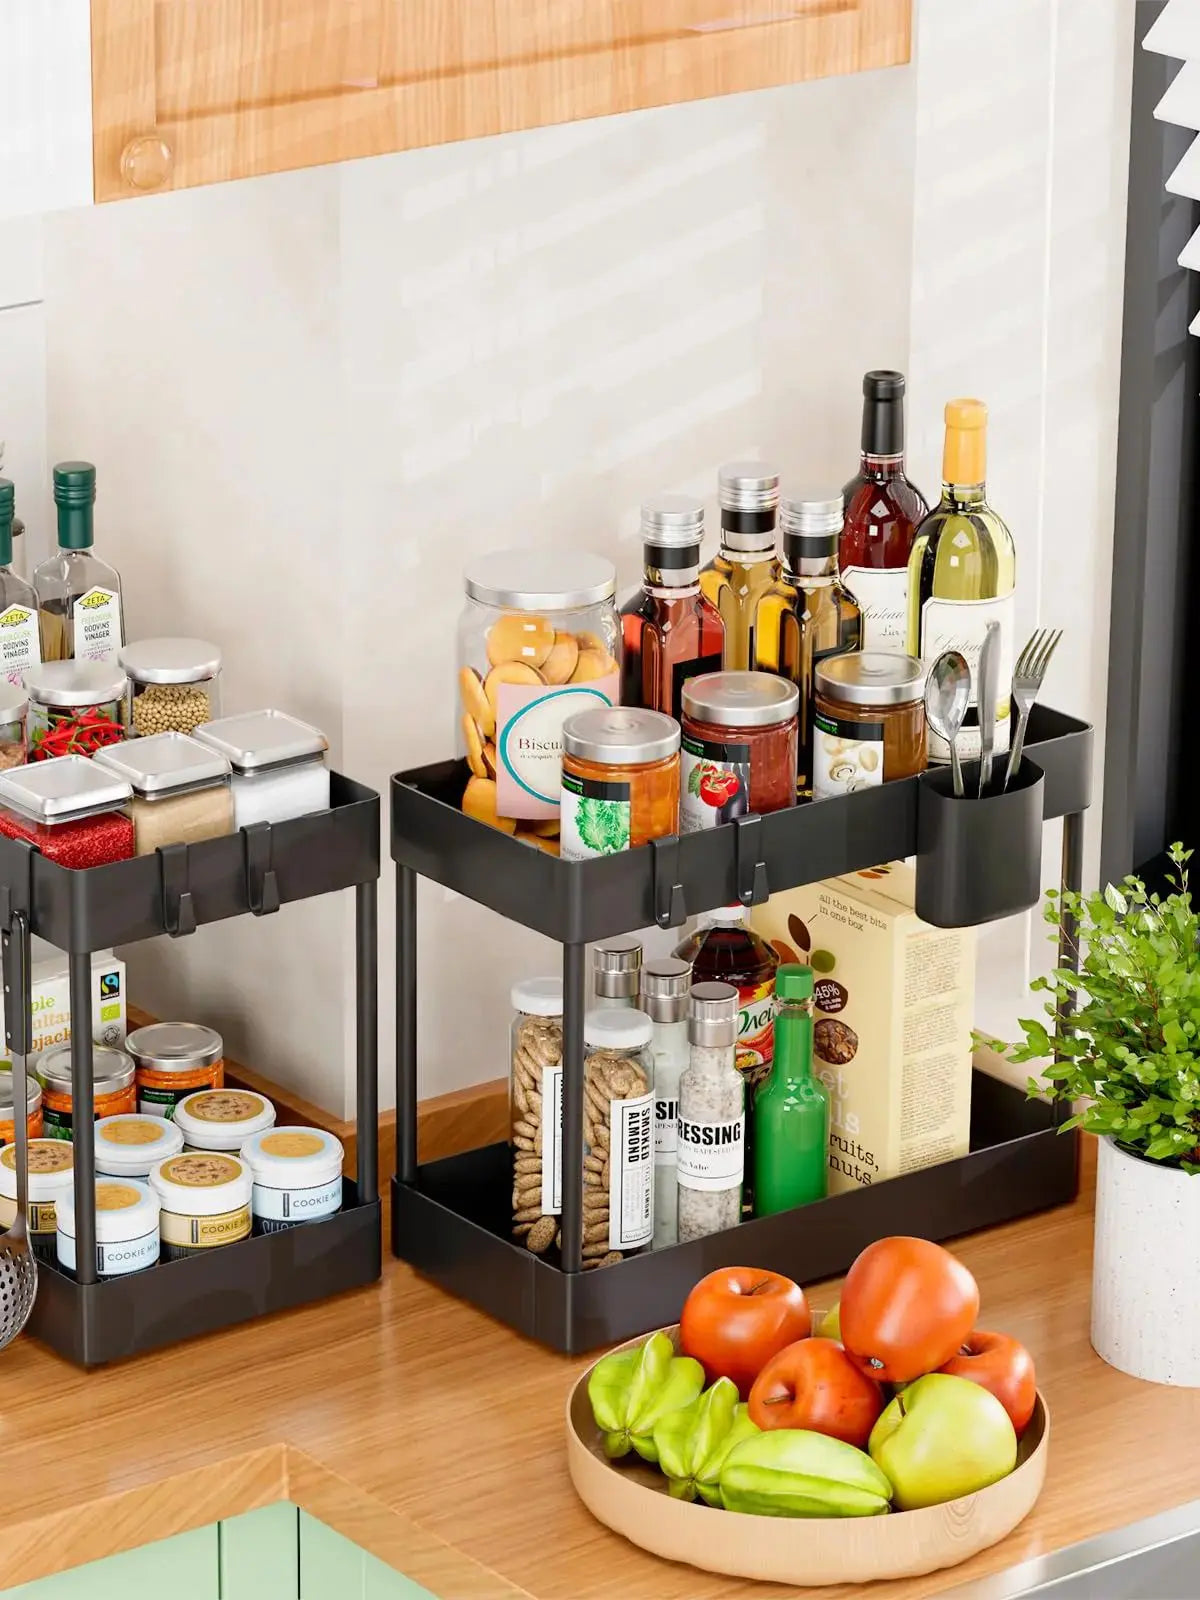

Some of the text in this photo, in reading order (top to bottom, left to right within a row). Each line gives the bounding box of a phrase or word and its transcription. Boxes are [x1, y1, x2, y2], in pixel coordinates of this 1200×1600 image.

[87, 595, 105, 605] ZETA
[5, 613, 24, 622] ZETA
[84, 630, 110, 641] VINAGER
[3, 648, 29, 659] VINAGER
[819, 894, 887, 930] all the best bits
[830, 911, 847, 924] one
[847, 917, 864, 932] box
[815, 983, 841, 999] 45%
[628, 1107, 651, 1163] SMOKED ALMOND
[678, 1118, 742, 1146] RESSING
[829, 1132, 879, 1173] ruits,
[293, 1193, 329, 1208] COOKIE
[201, 1216, 239, 1235] COOKIE
[107, 1247, 146, 1262] COOKIE
